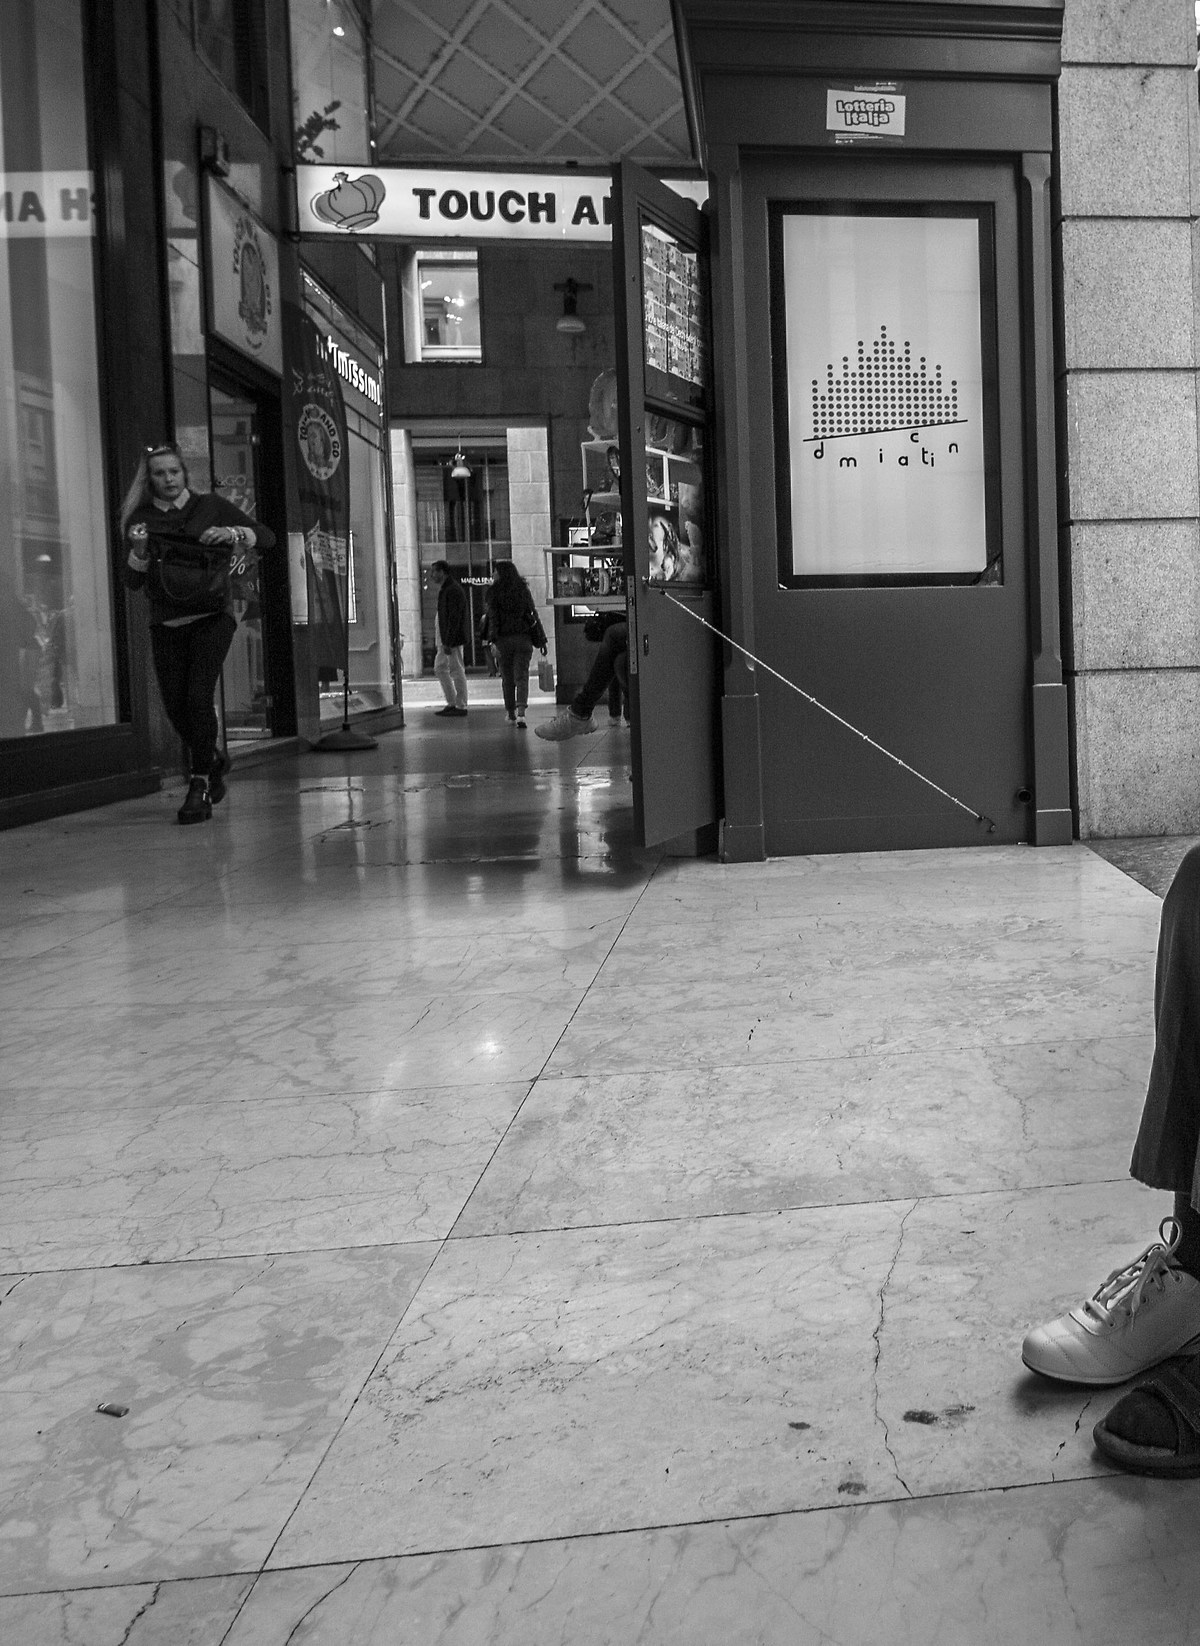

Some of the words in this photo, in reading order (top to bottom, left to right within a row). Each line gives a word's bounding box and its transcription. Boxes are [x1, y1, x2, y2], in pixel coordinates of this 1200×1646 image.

[836, 98, 895, 113] Lotteria
[845, 111, 890, 127] Italia
[412, 188, 556, 223] TOUCH
[320, 413, 336, 437] AND
[332, 441, 340, 458] GO
